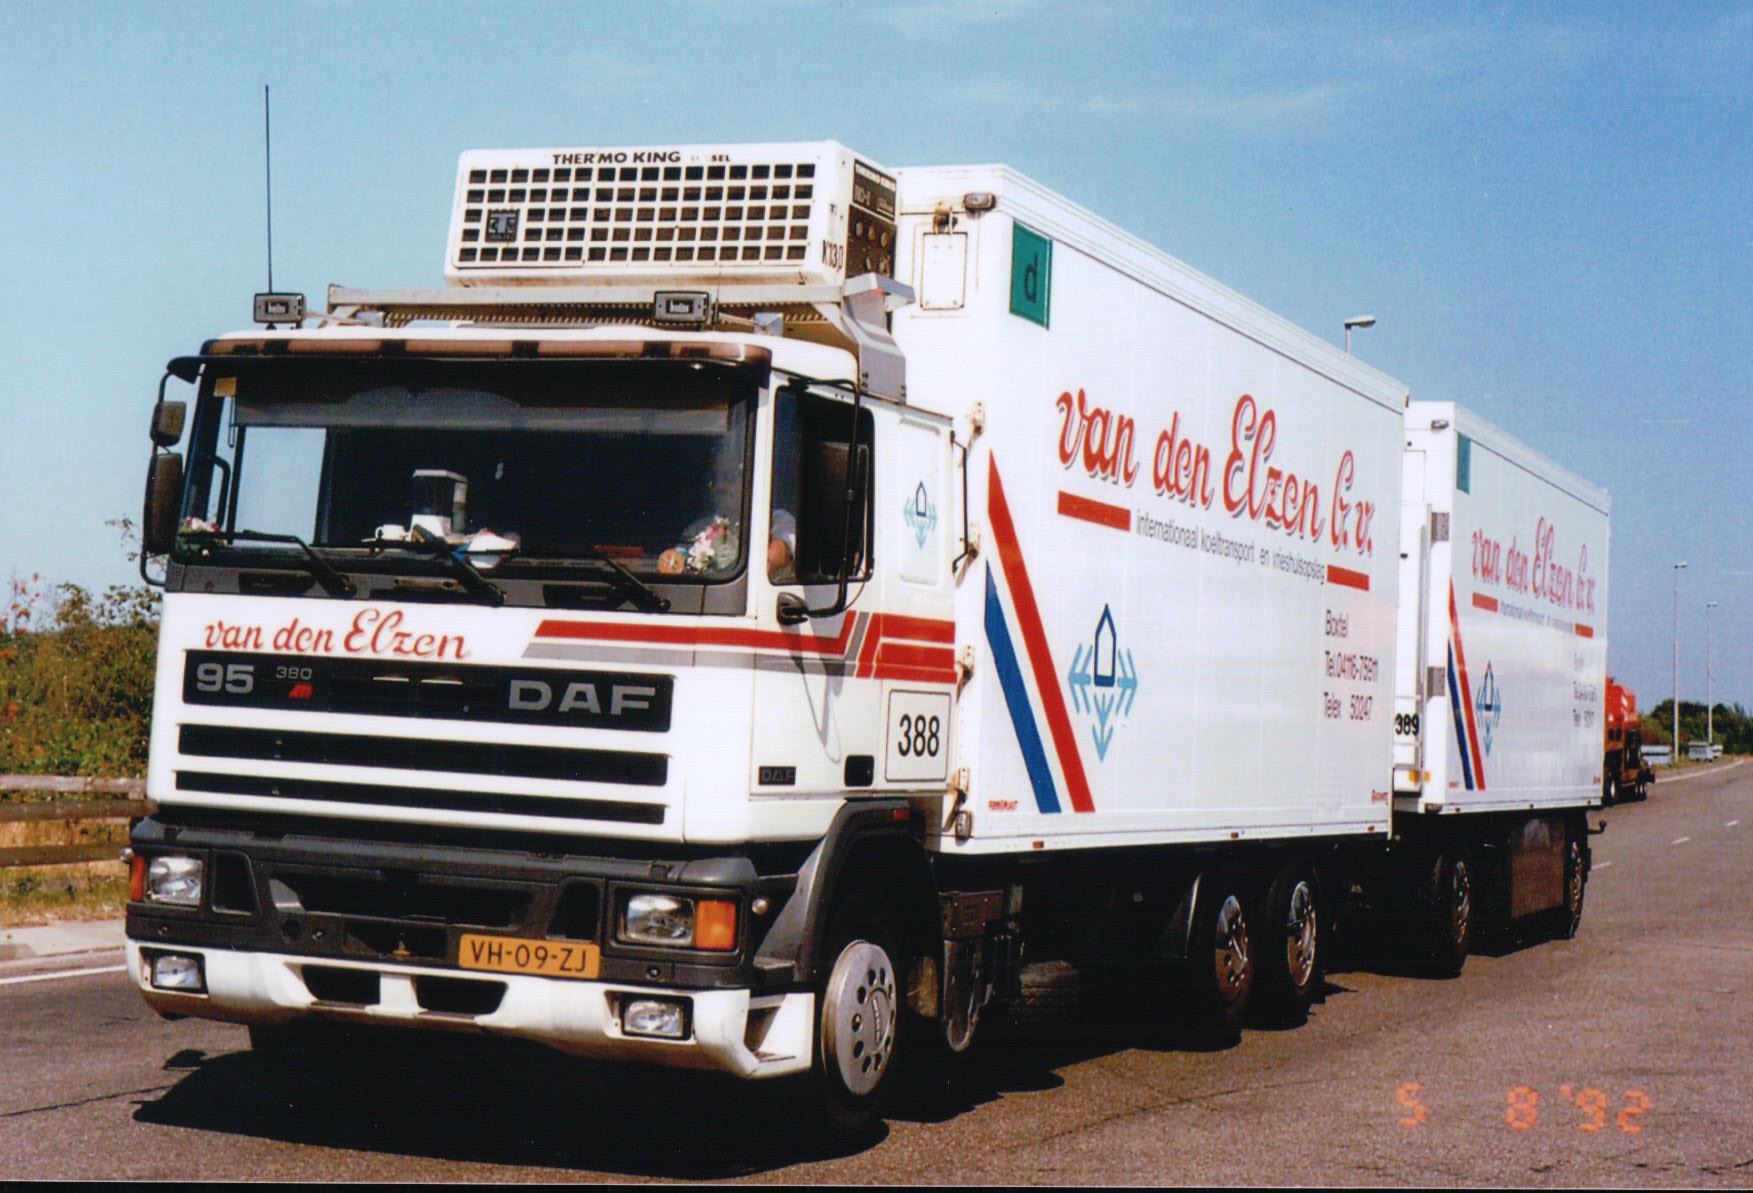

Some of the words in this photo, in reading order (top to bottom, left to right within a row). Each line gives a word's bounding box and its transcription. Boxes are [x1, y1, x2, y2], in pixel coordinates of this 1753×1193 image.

[552, 152, 627, 165] THERMO
[633, 151, 681, 163] KING
[1024, 252, 1038, 304] d
[1056, 388, 1140, 487] van
[1153, 411, 1214, 510] den
[1223, 394, 1326, 543] Elzen
[1136, 509, 1198, 550] internationaal
[1200, 527, 1255, 567] koeltransport
[1259, 547, 1272, 566] en
[1472, 529, 1500, 585] van
[1505, 535, 1529, 594] den
[1532, 516, 1574, 609] Elzen
[204, 620, 264, 651] van
[272, 617, 335, 653] den
[343, 608, 471, 660] Elzen
[196, 662, 254, 693] 95
[275, 665, 313, 680] 380
[508, 679, 656, 716] DAF
[898, 714, 940, 757] 388
[1395, 713, 1420, 736] 389
[761, 769, 794, 782] DAF
[471, 939, 587, 973] VH-09-ZJ
